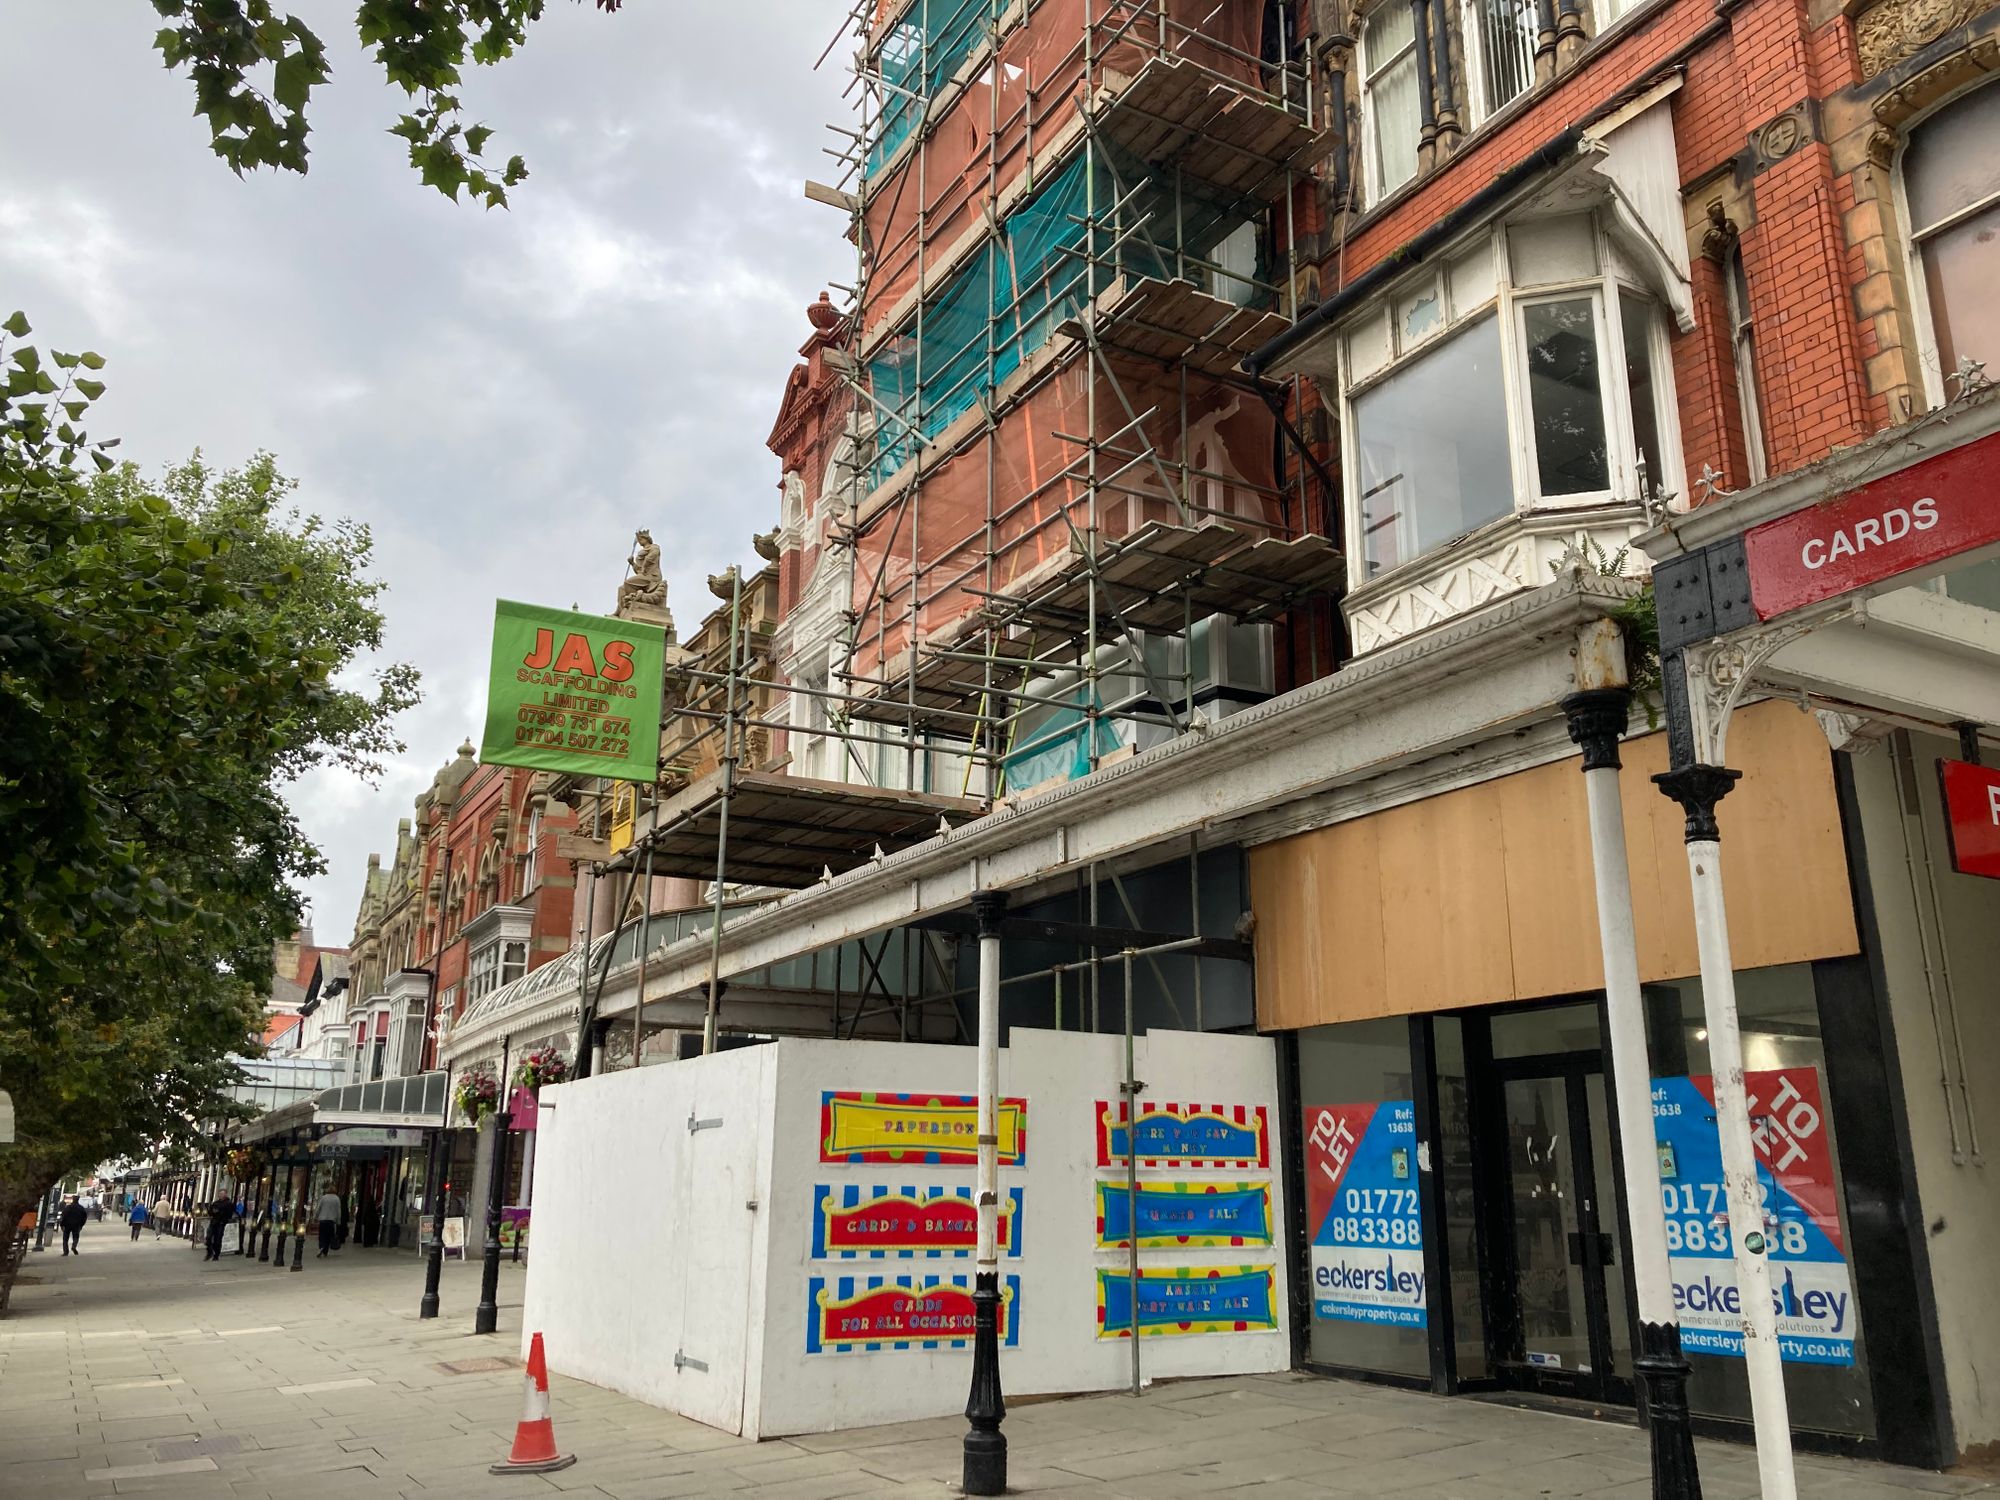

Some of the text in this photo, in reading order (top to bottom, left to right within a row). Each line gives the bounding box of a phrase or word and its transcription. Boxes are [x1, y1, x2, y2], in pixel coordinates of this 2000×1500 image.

[1802, 497, 1939, 569] CARDS
[522, 627, 636, 683] JAS
[516, 668, 637, 699] SCAFFOLDING
[543, 691, 610, 713] LIMITED
[570, 715, 597, 731] 731
[515, 725, 630, 754] 01704 507 272
[1652, 1088, 1667, 1100] ef:
[1770, 1075, 1820, 1139] TO
[1394, 1109, 1412, 1120] Ref:
[1652, 1104, 1682, 1116] 3638
[1309, 1110, 1336, 1151] TO
[1388, 1122, 1413, 1133] 13638
[1320, 1118, 1355, 1183] LET
[1346, 1189, 1418, 1215] 01772
[1661, 1183, 1771, 1215] 0172
[1209, 1208, 1239, 1220] SALE
[1333, 1217, 1421, 1245] 883388
[1666, 1219, 1808, 1254] 88388
[1316, 1253, 1425, 1304] eckersley
[1672, 1266, 1848, 1334] eckesley
[841, 1317, 870, 1331] FOR
[909, 1315, 976, 1329] OCCASIO
[1675, 1314, 1722, 1326] ommercial
[1779, 1321, 1826, 1333] olutions
